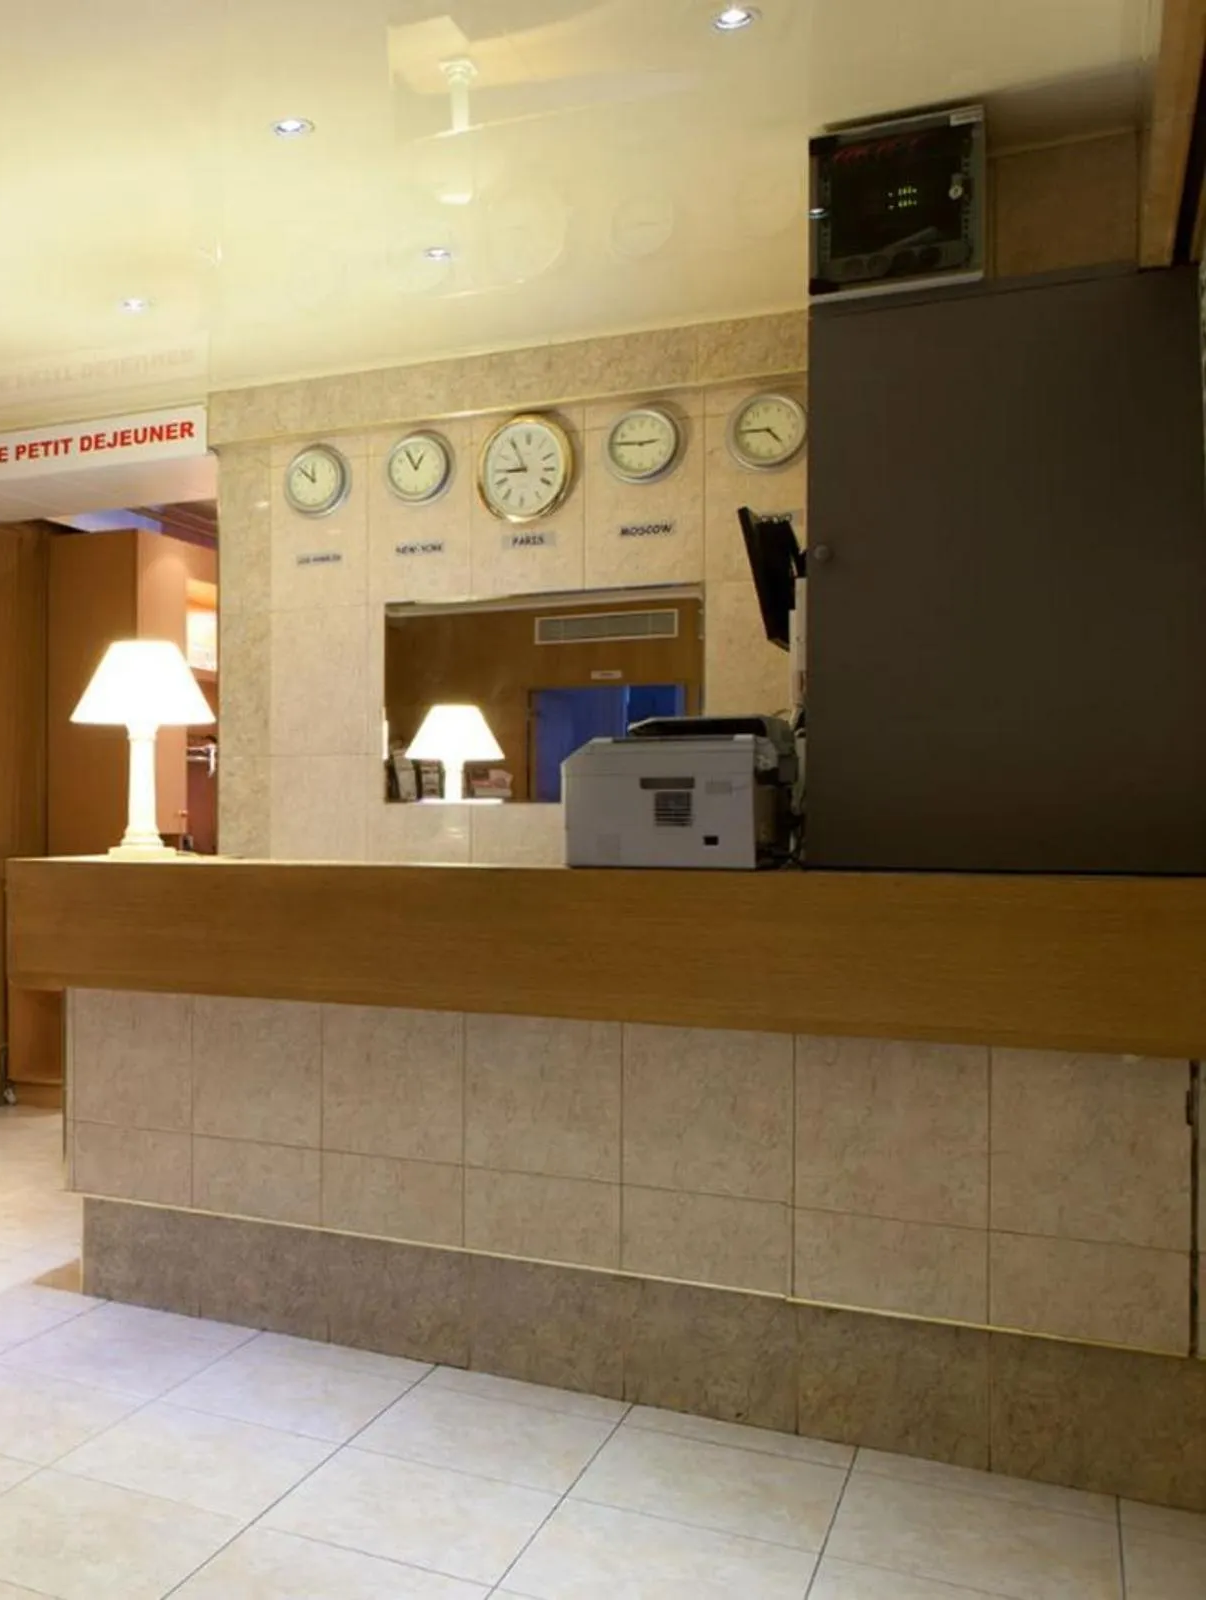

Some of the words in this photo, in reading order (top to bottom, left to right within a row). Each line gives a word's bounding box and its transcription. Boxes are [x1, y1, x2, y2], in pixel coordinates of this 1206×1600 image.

[15, 438, 73, 461] PETIT
[79, 421, 194, 453] DEJEUNER
[620, 524, 673, 536] MOSCOW
[512, 535, 545, 547] PARIS
